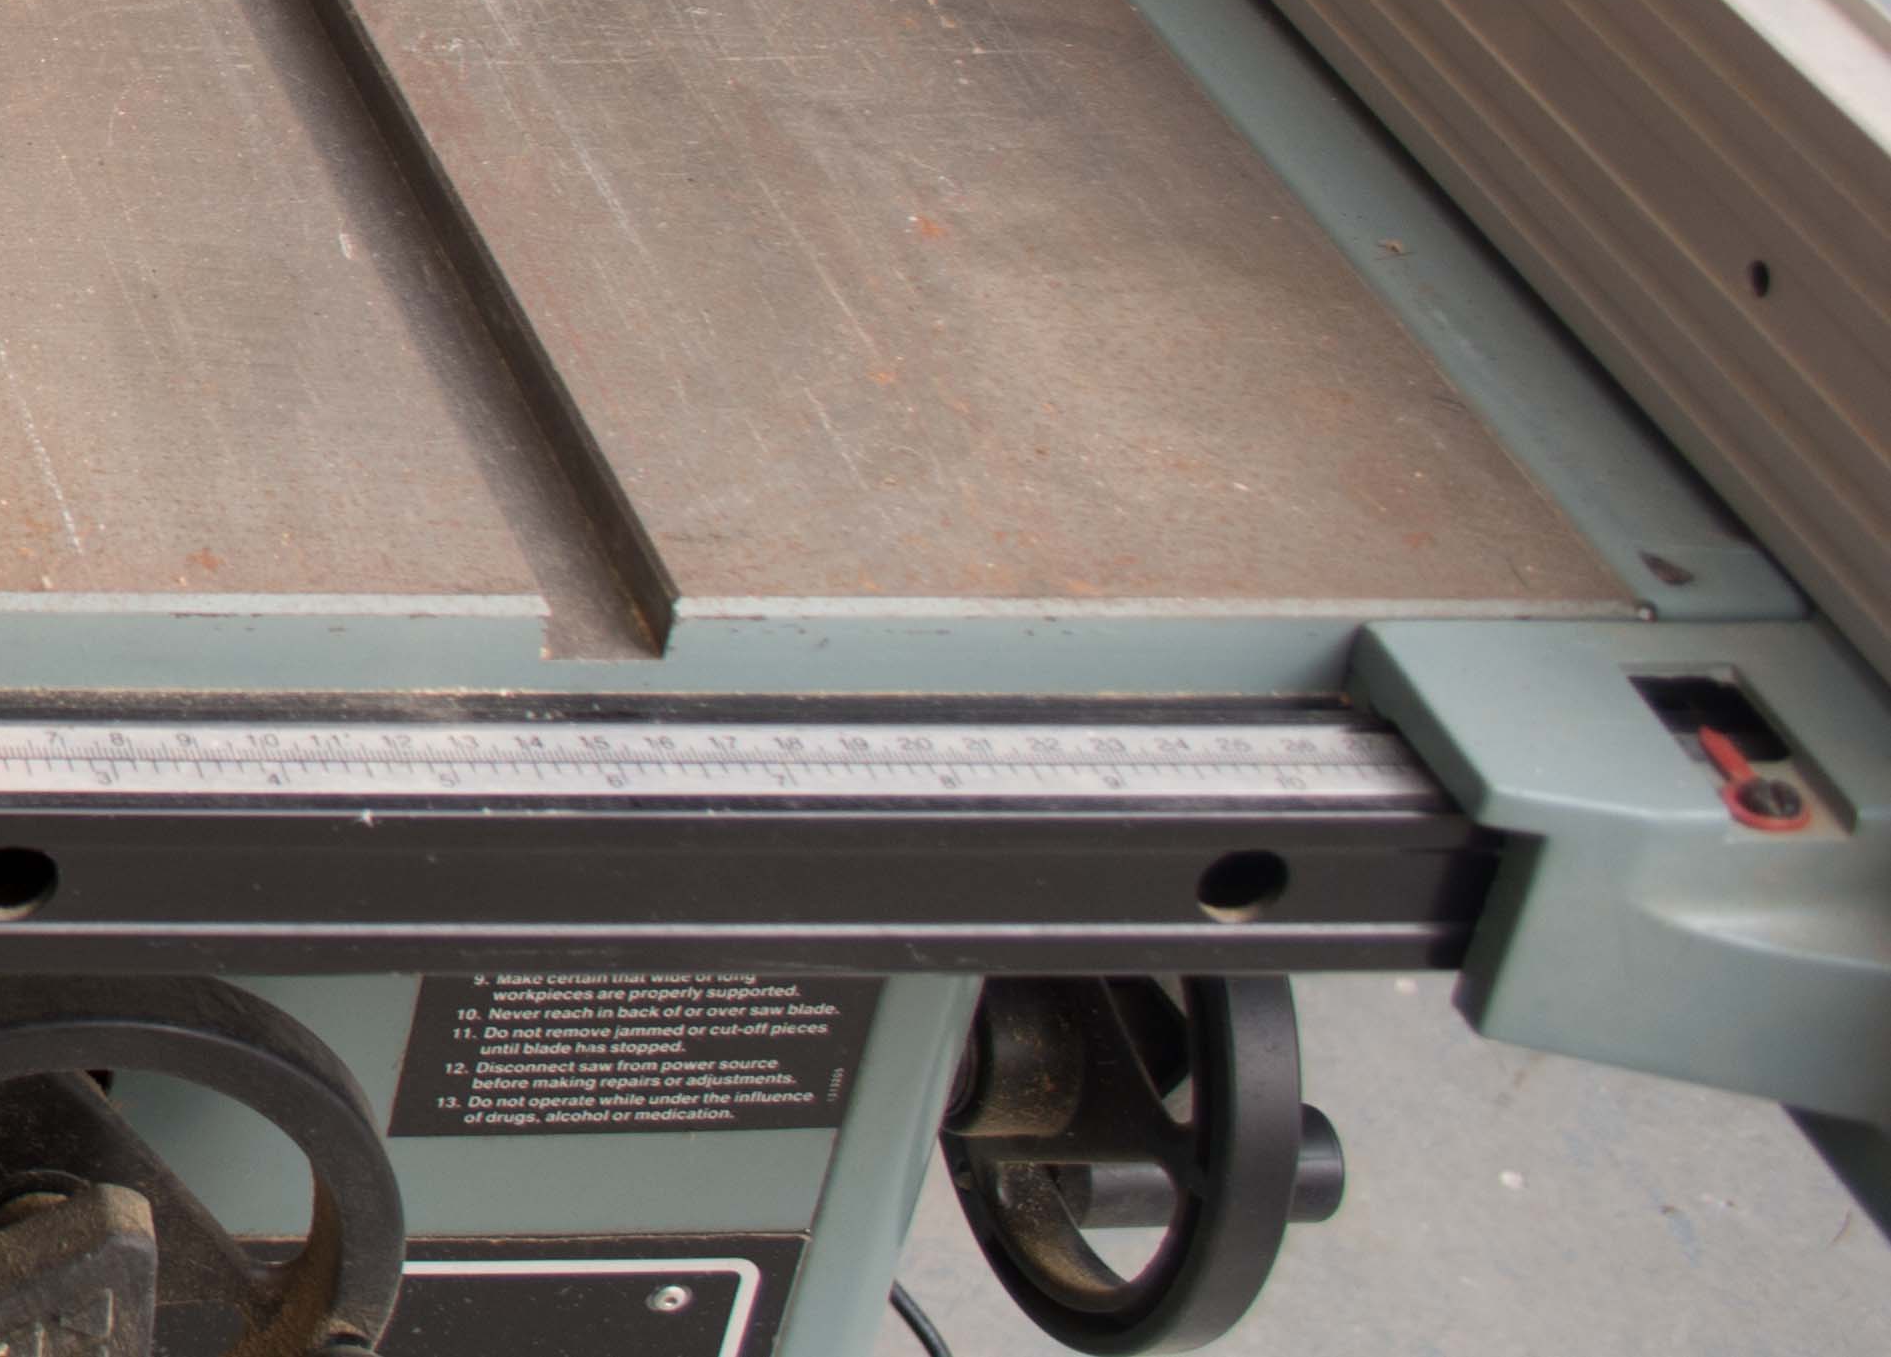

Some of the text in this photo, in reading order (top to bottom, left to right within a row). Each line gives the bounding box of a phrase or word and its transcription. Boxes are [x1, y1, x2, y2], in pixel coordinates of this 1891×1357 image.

[496, 973, 543, 984] Make
[547, 973, 607, 984] certain
[493, 985, 801, 1002] workpieces are properly supported.
[457, 1002, 840, 1020] 10. Never reach in back of or over saw blade.
[453, 1022, 828, 1039] 11. Do not remove jammed or cut-off pieces
[480, 1040, 686, 1055] until blade has stopped.
[445, 1059, 778, 1074] 12. Disconnect saw from power source
[472, 1073, 797, 1091] before making repairs or adjustments.
[437, 1091, 813, 1109] 13. Do not operate while under the influence
[464, 1112, 482, 1124] of
[545, 1110, 610, 1124] alcohol
[612, 1111, 632, 1121] or
[634, 1108, 735, 1121] medication.
